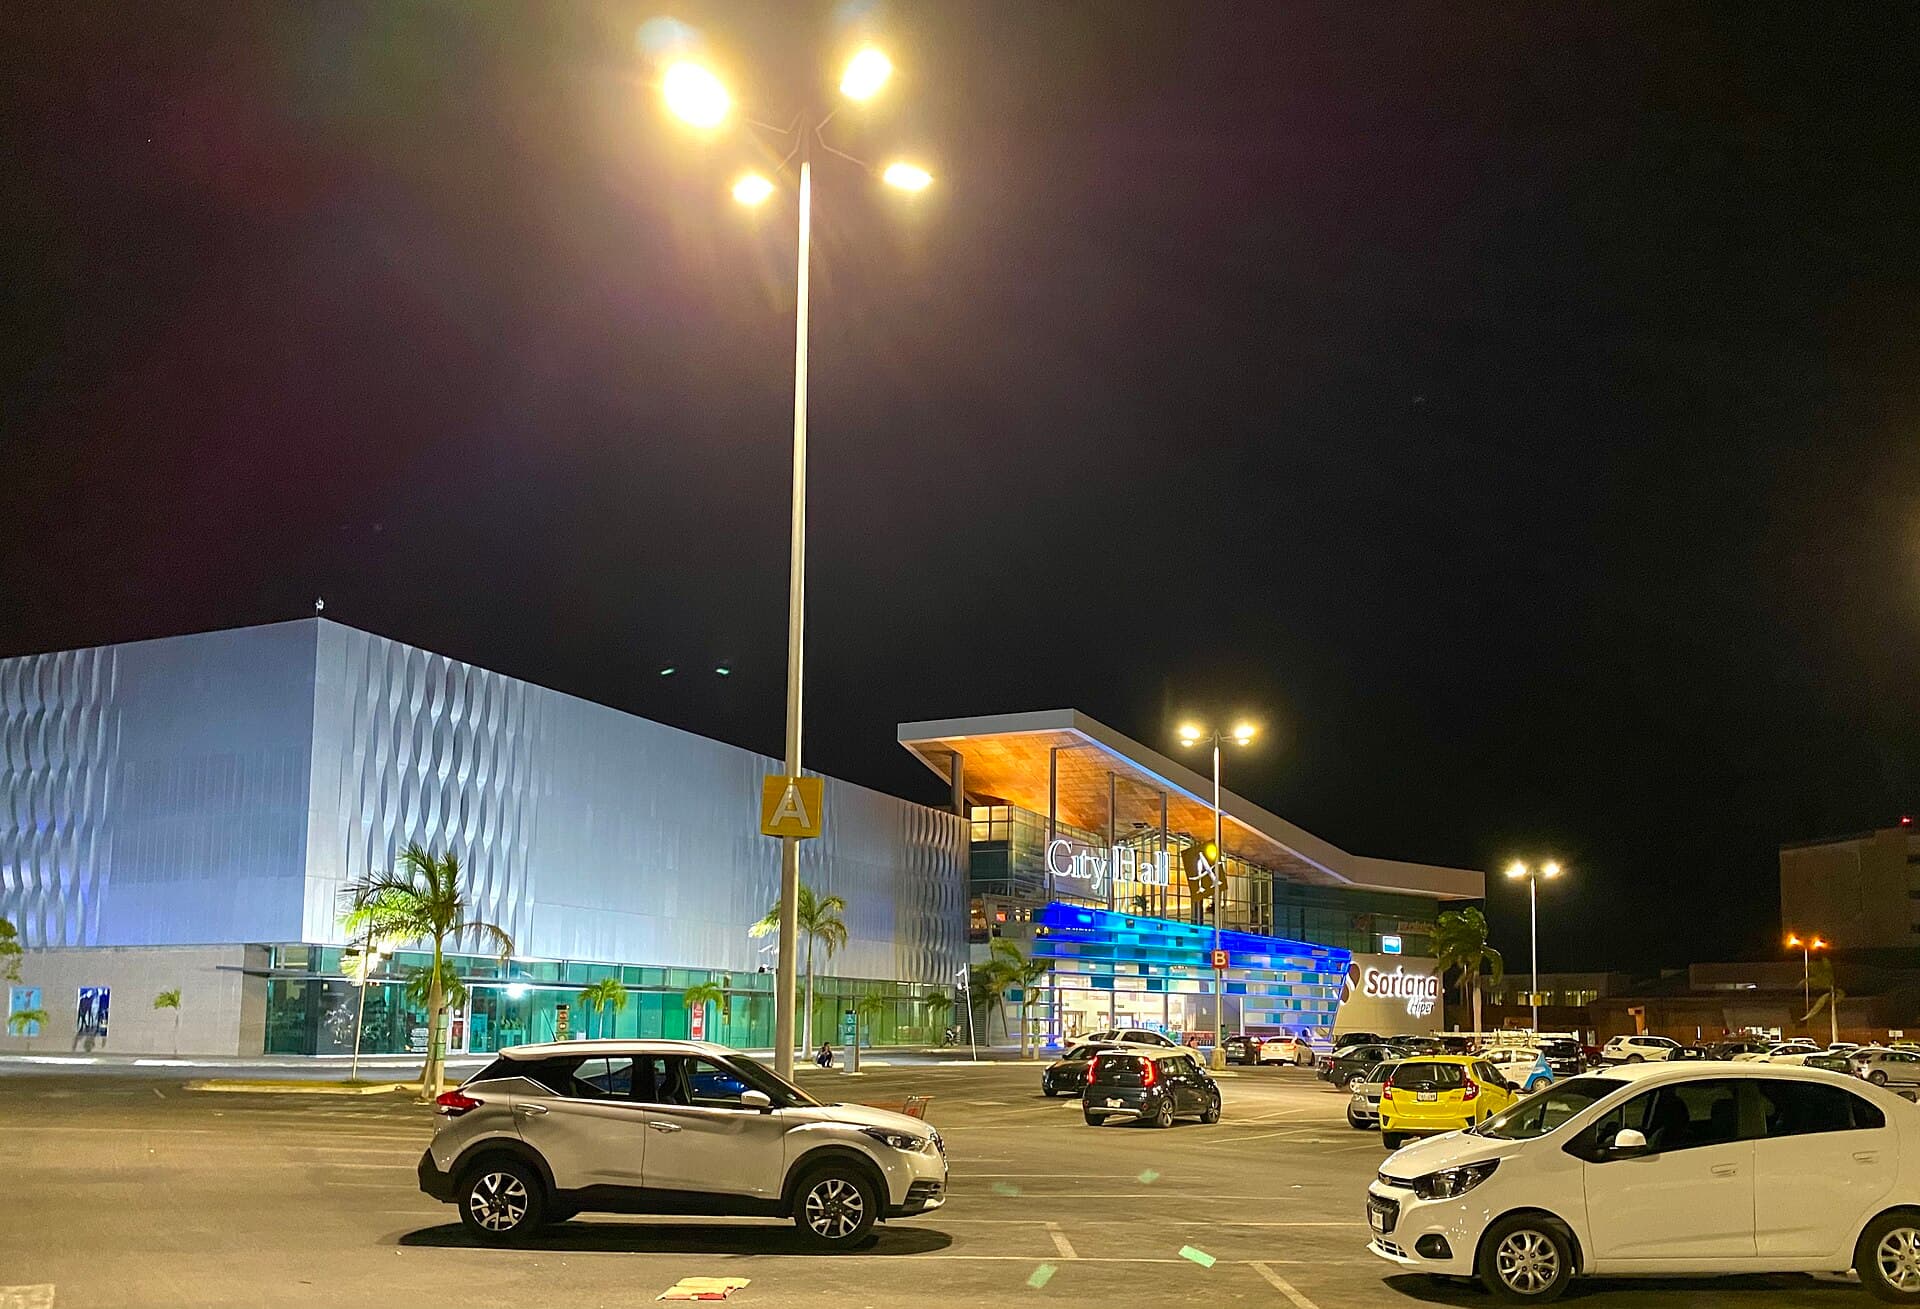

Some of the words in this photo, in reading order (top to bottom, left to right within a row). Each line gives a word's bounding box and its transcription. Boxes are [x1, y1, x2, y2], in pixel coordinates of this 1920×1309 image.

[768, 784, 811, 828] A
[1048, 839, 1107, 890] City
[1112, 845, 1170, 887] Hall
[1214, 950, 1226, 965] B
[1366, 967, 1439, 997] Soriana
[1410, 999, 1435, 1017] Hiper
